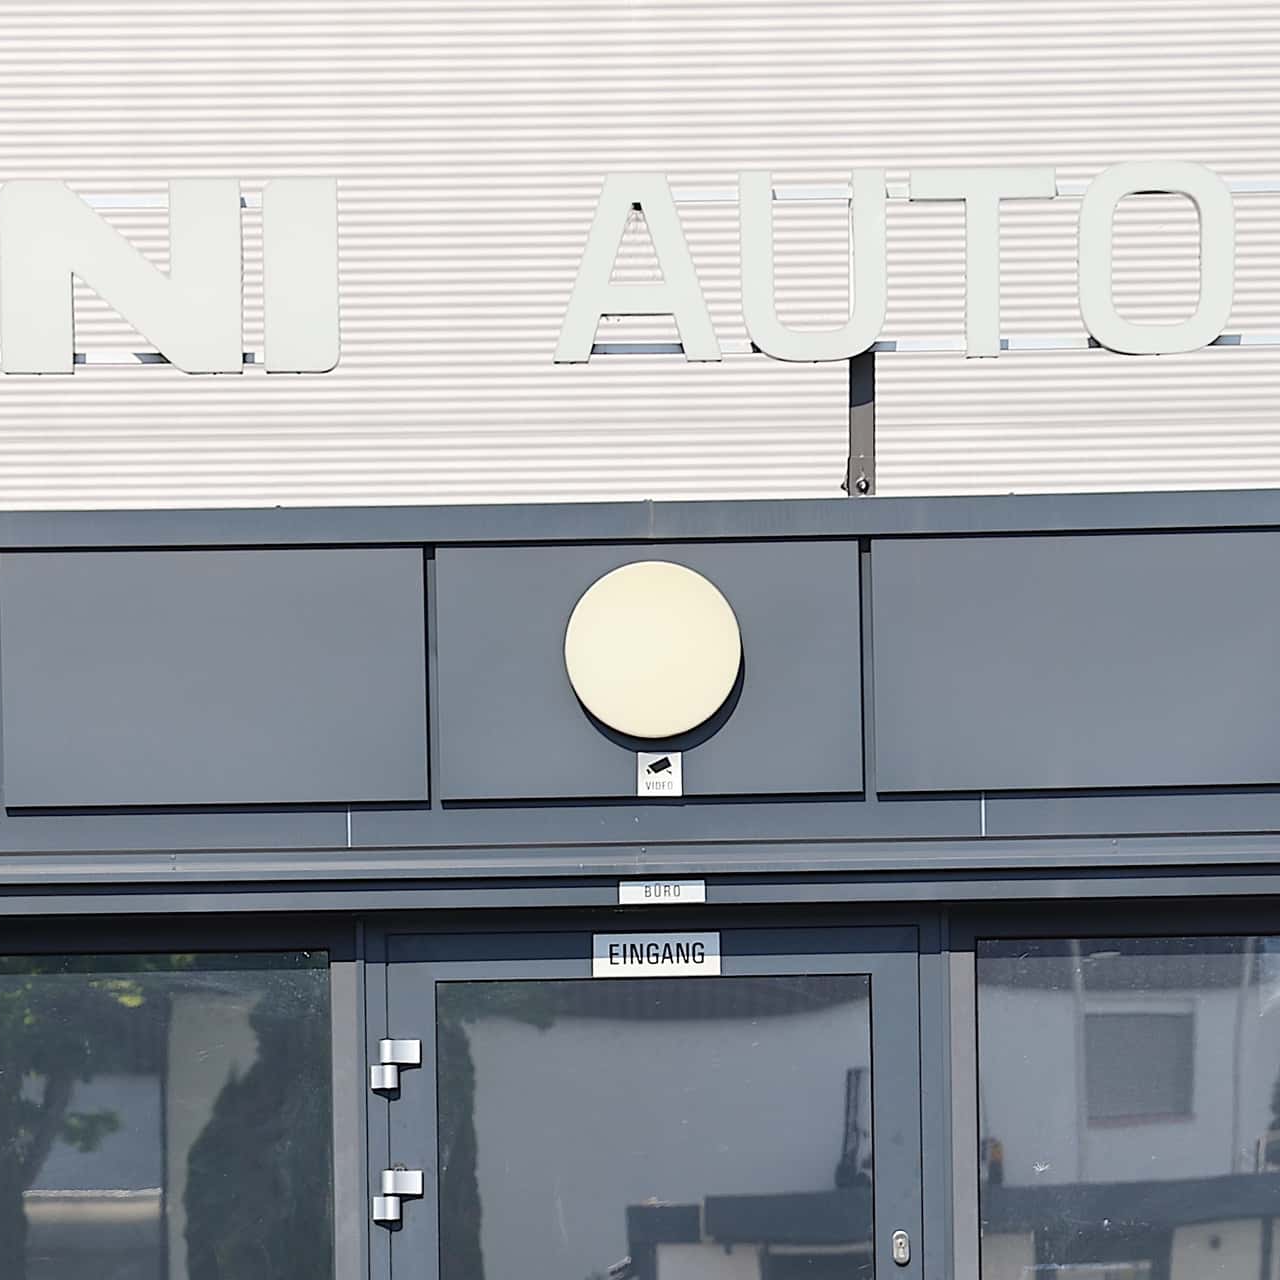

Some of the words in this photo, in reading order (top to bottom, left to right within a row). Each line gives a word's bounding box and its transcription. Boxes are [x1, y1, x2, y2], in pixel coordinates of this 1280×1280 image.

[554, 159, 1237, 364] AUTO
[645, 781, 673, 790] VIDEO
[609, 942, 705, 965] EINGANG
